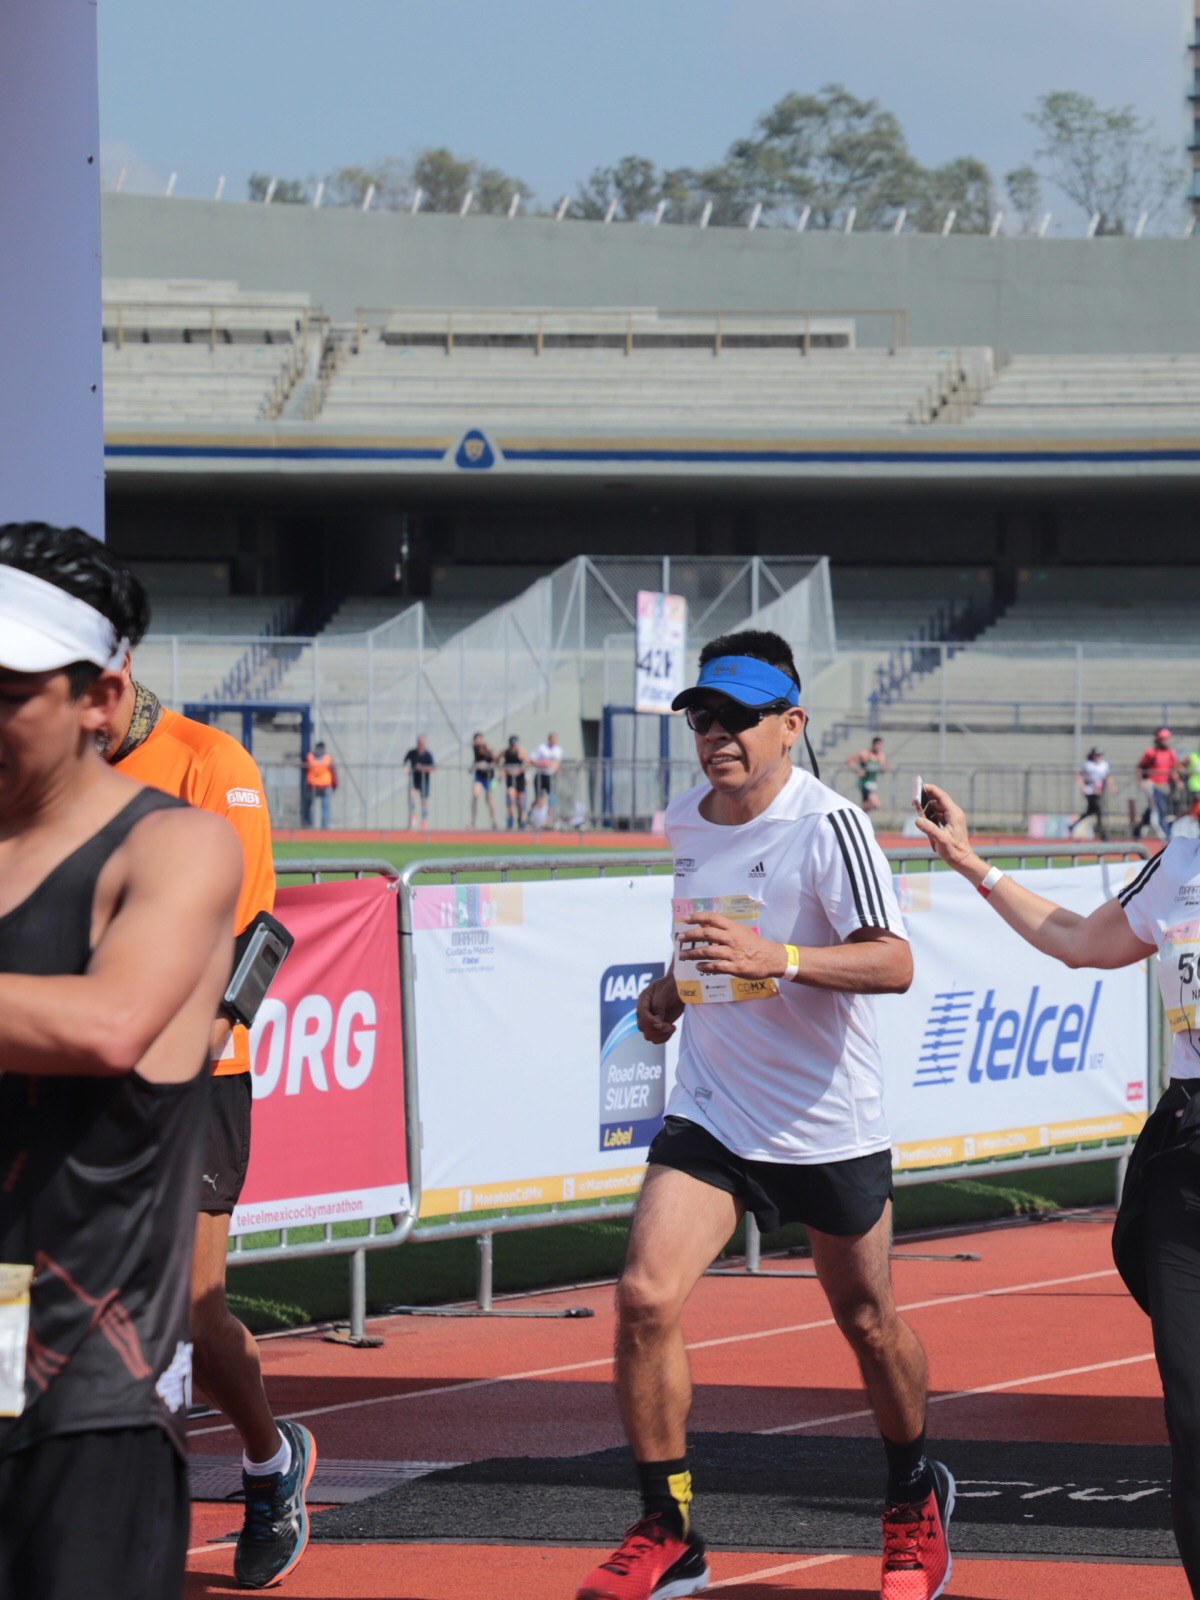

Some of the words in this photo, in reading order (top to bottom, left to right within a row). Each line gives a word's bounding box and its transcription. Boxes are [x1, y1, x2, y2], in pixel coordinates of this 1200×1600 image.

[604, 972, 653, 1002] IAAF
[738, 981, 767, 993] CDMX
[250, 989, 377, 1100] ORG
[968, 980, 1103, 1084] telcel
[608, 1064, 635, 1084] Road
[636, 1061, 662, 1080] Race
[604, 1084, 650, 1111] SILVER
[603, 1126, 633, 1148] Label
[236, 1200, 363, 1227] telcelmexicocitymarathon
